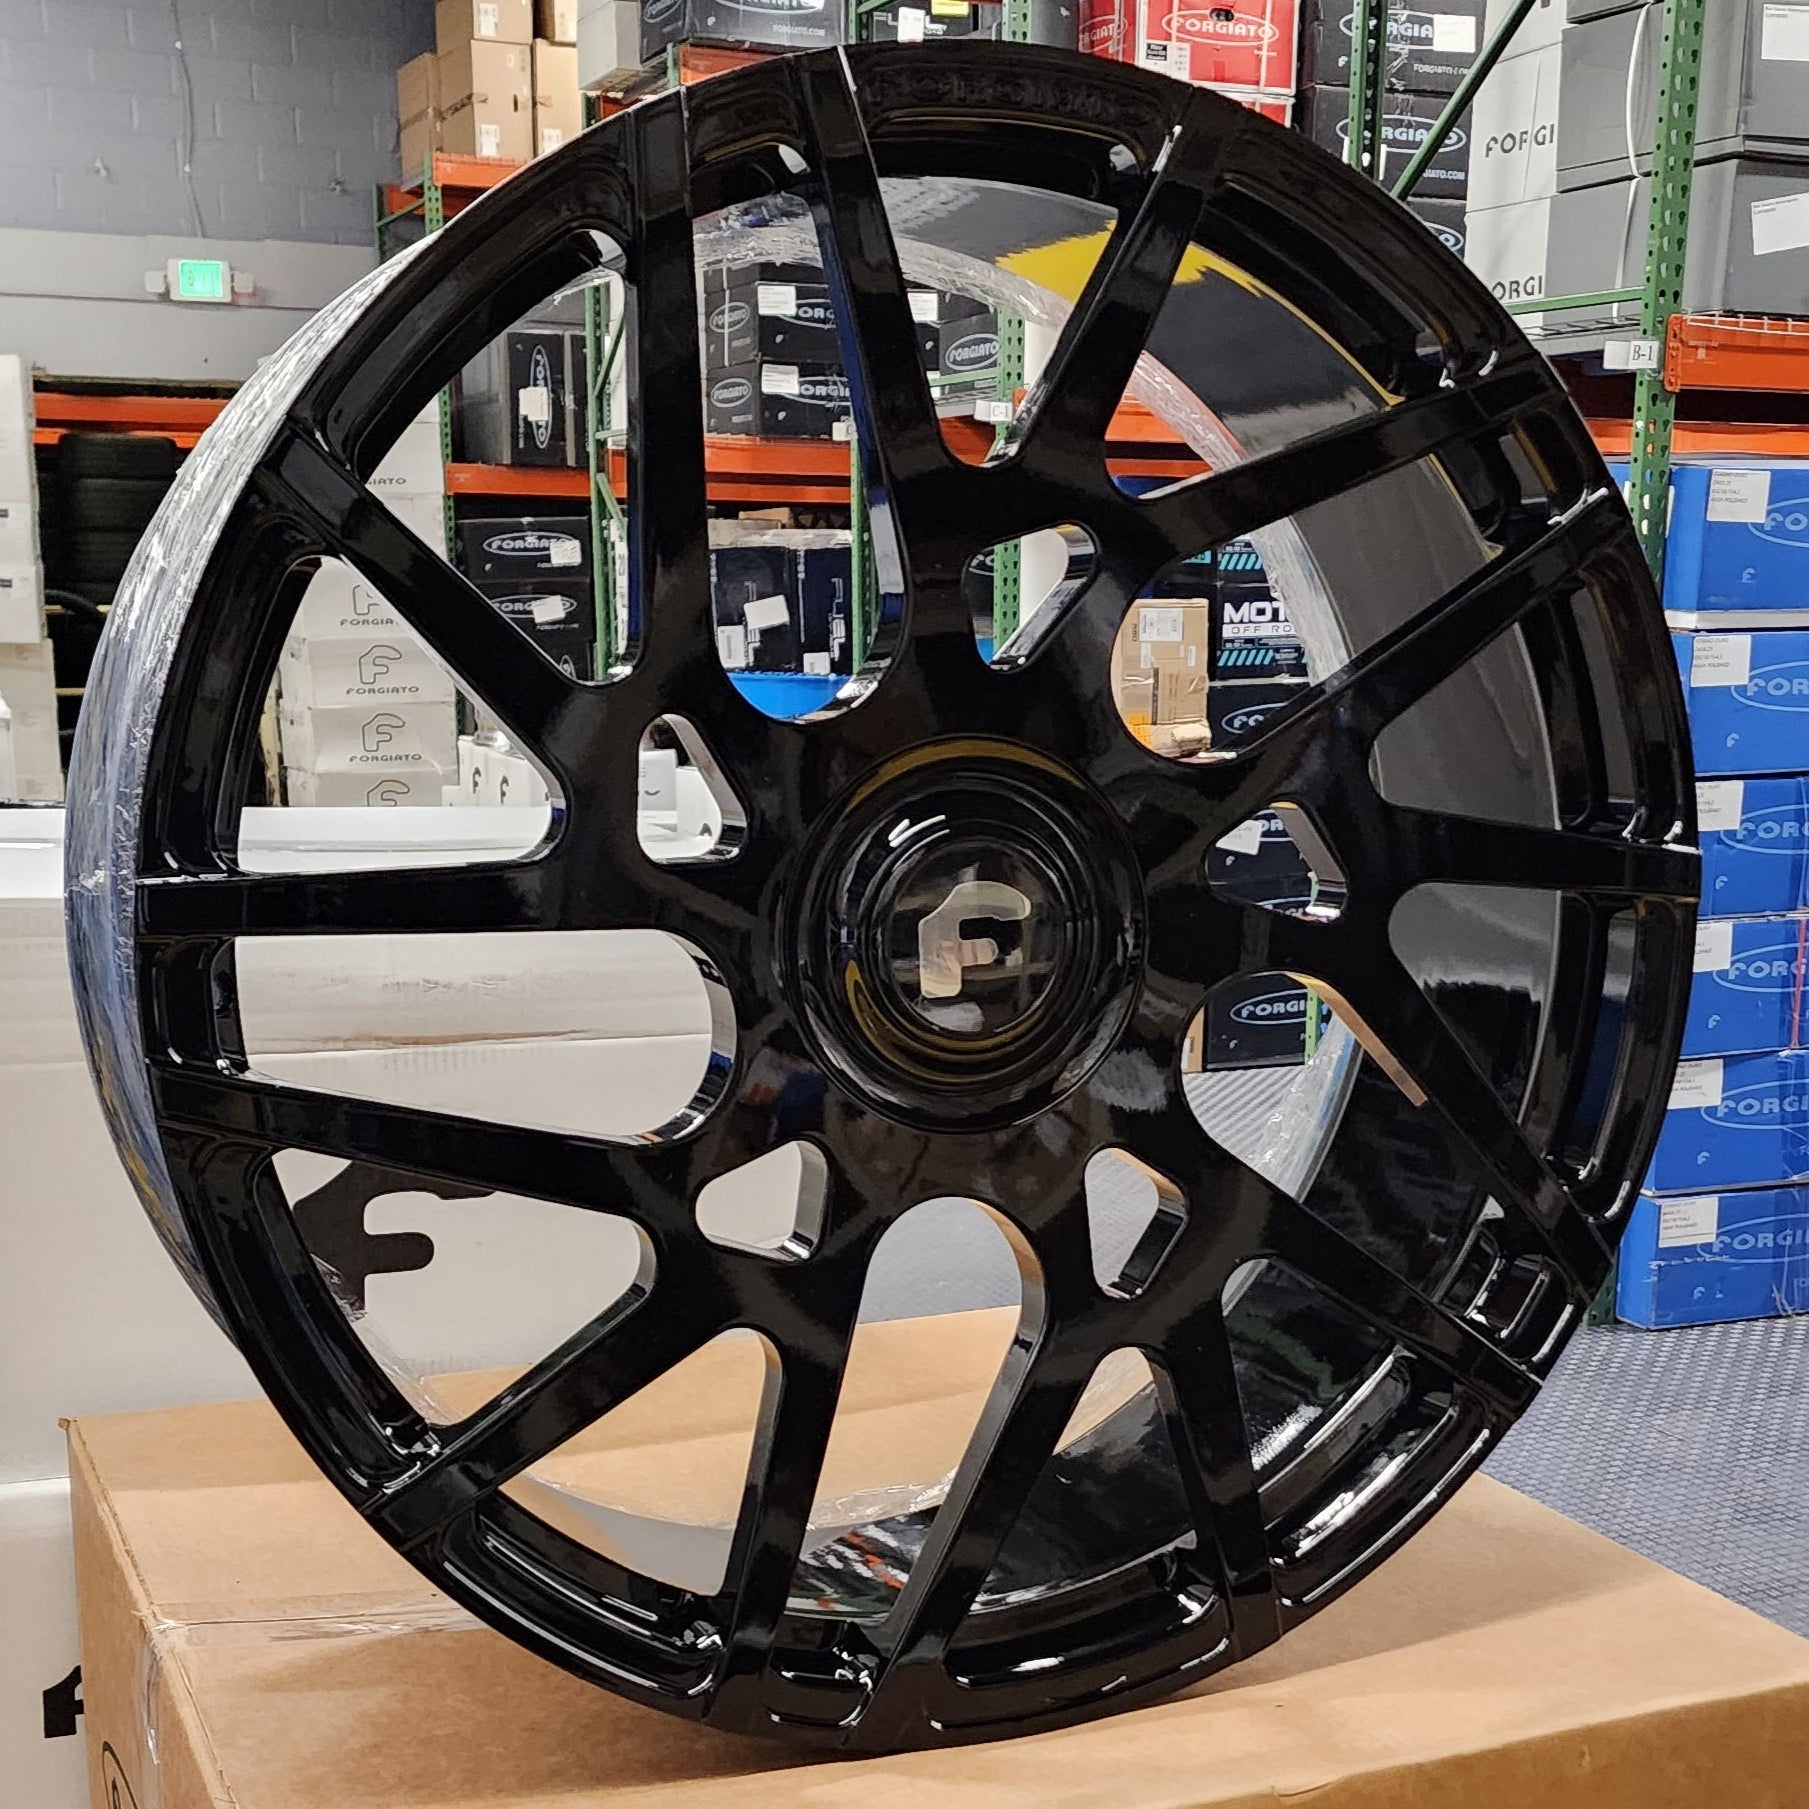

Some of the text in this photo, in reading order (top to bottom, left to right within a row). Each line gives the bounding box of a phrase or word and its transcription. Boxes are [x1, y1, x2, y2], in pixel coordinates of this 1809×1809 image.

[1171, 17, 1274, 39] FORGIATO
[1492, 275, 1543, 300] ORGI
[1632, 344, 1653, 361] B-1
[1224, 602, 1286, 623] MOT
[340, 617, 399, 627] FORGIA
[1231, 625, 1262, 635] OFF
[346, 685, 420, 696] FORGIATO
[1747, 677, 1809, 697] FOR
[349, 752, 422, 763] FORGIATO
[1241, 1000, 1305, 1018] FORGI
[1716, 1094, 1809, 1118] FORGI
